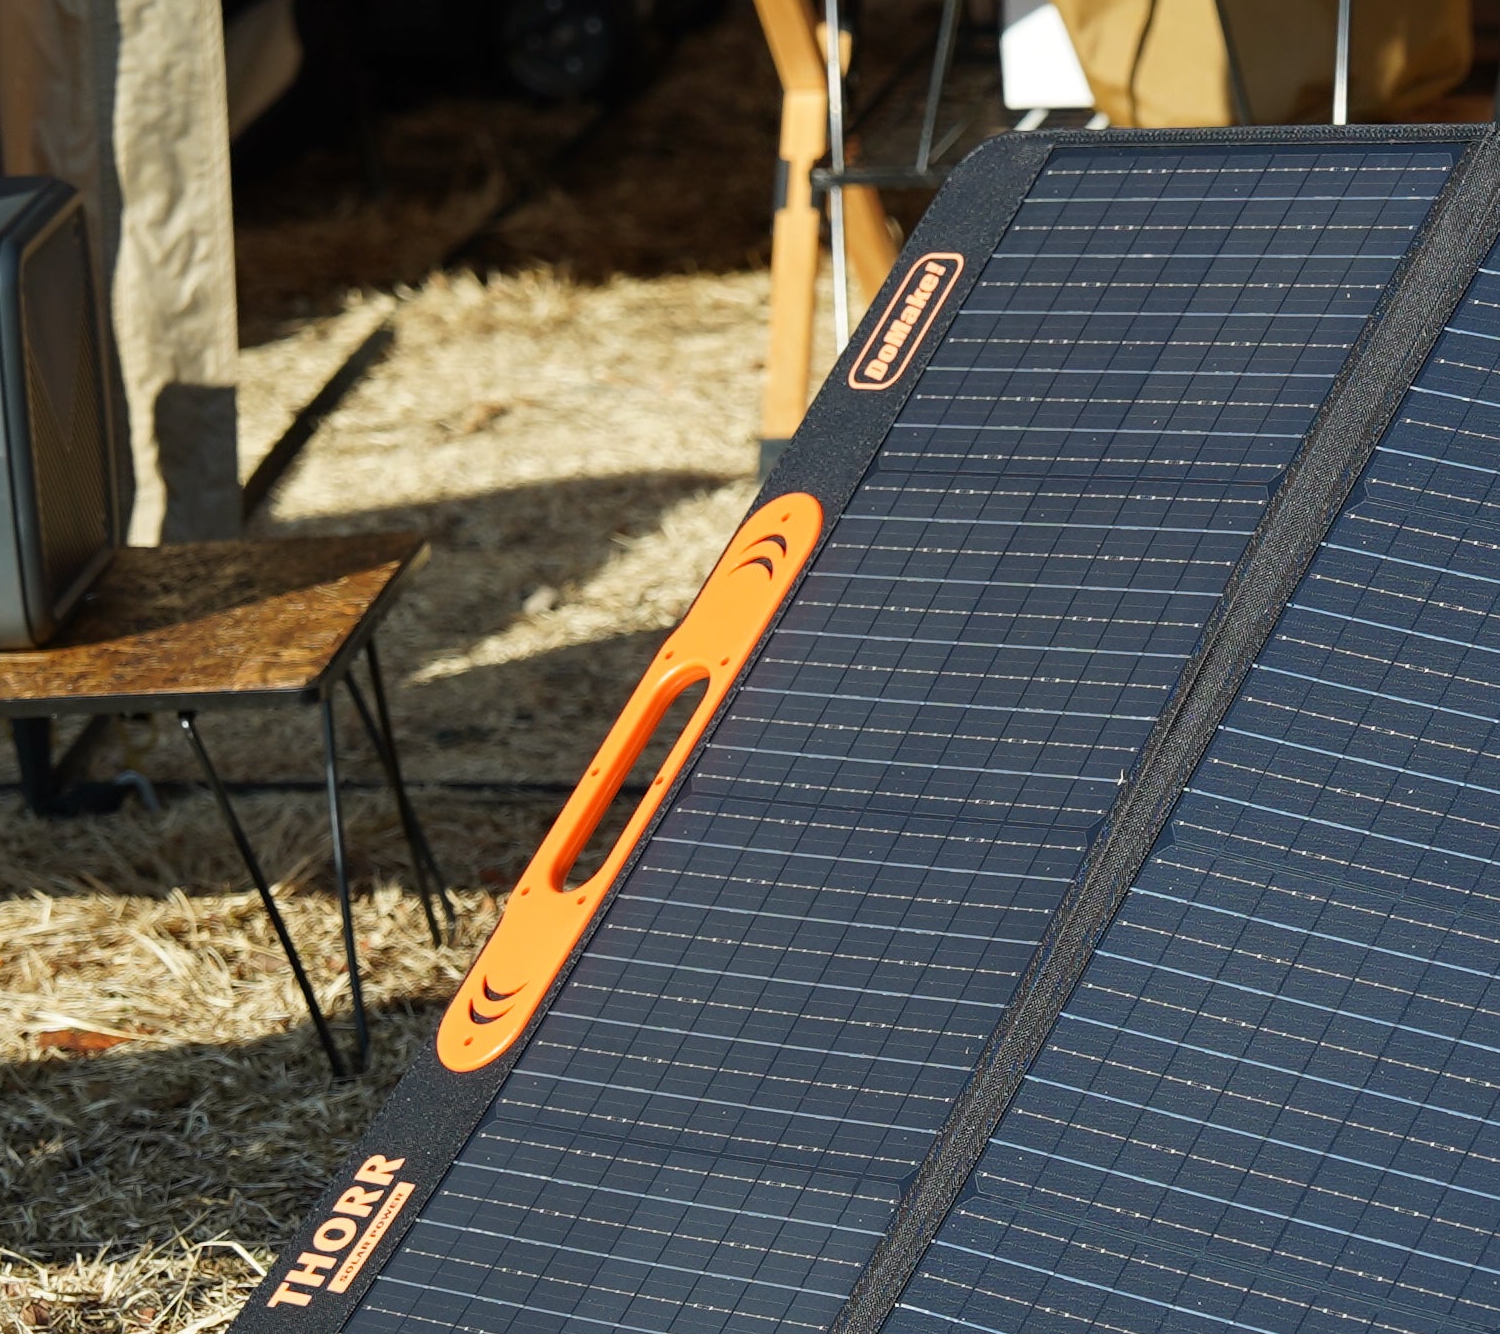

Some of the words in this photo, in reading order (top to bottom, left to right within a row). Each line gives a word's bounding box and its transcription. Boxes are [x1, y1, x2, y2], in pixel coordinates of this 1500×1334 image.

[864, 261, 946, 381] DoMake!
[266, 1154, 406, 1308] THORR
[339, 1240, 370, 1283] SOLAR
[369, 1192, 404, 1239] POWER
